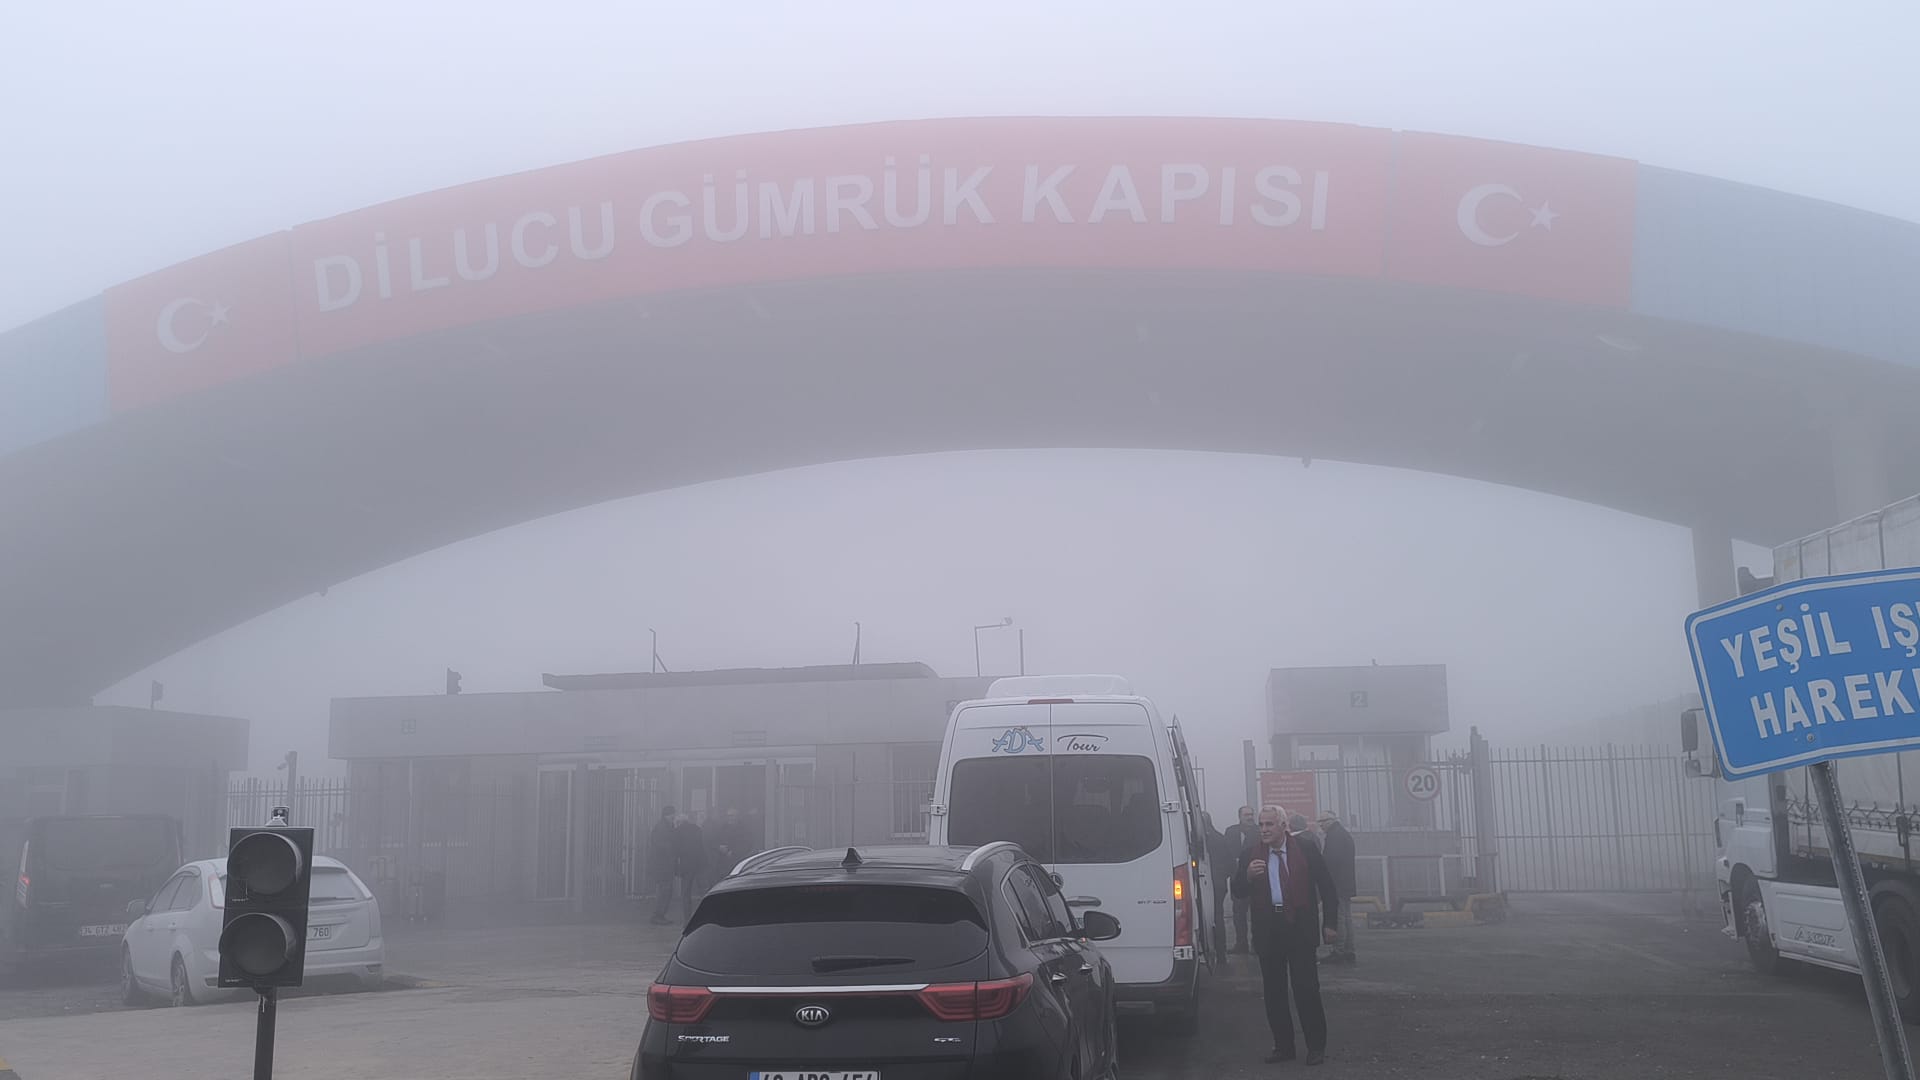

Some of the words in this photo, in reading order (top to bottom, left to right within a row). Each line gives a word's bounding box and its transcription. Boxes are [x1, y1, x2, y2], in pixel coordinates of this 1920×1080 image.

[314, 200, 616, 312] DİLUCU
[639, 153, 995, 248] GÜMRÜK
[1021, 163, 1329, 230] KAPISI
[1720, 603, 1852, 678] YEŞİL
[1871, 601, 1920, 658] IŞ
[1750, 667, 1920, 739] HAREK
[992, 727, 1045, 754] ADA
[1057, 734, 1109, 752] Tour
[1410, 775, 1436, 792] 20
[313, 927, 329, 937] 760
[801, 1010, 823, 1021] KIA
[678, 1035, 730, 1043] SPORTAGE
